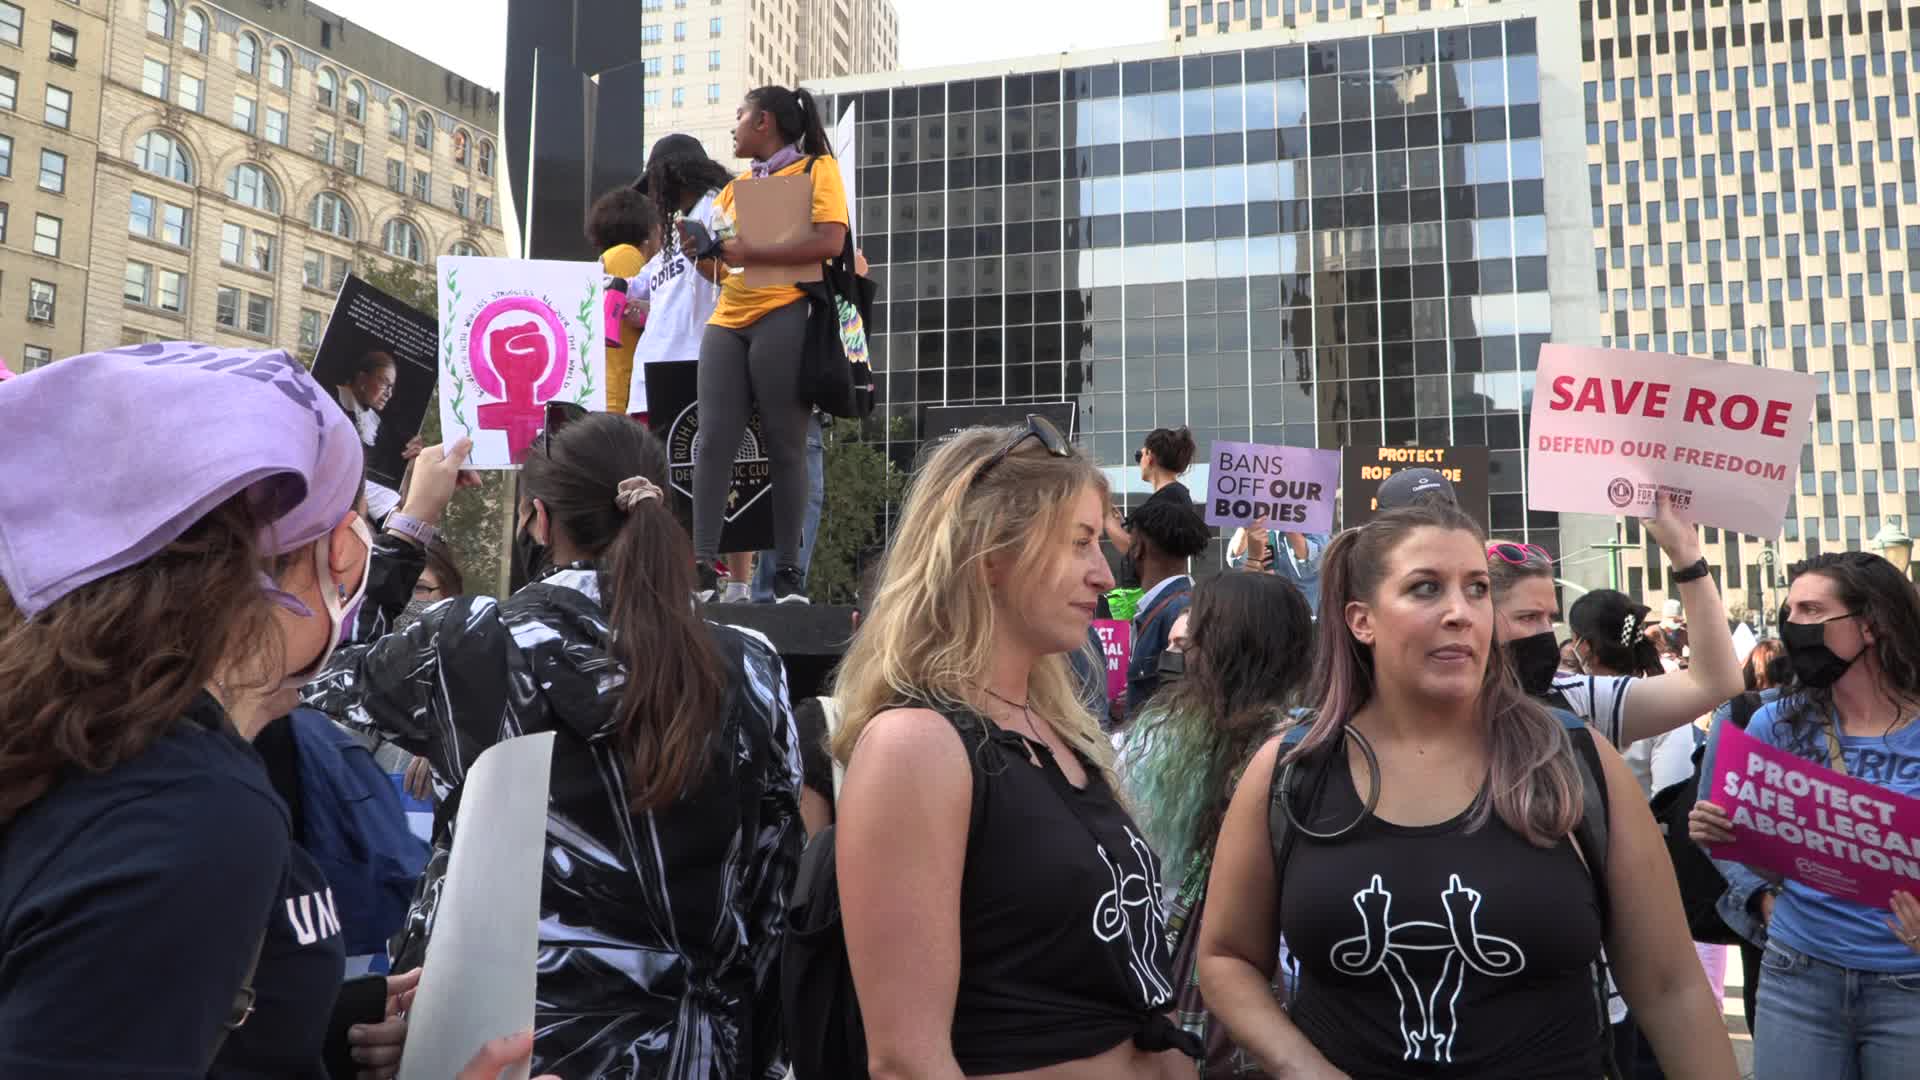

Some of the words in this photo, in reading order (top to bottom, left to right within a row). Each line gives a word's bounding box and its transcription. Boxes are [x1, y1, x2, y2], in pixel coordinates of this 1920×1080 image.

[651, 258, 685, 291] ODIES
[1550, 375, 1671, 419] SAVE
[1682, 388, 1793, 438] ROE
[673, 425, 693, 460] RUTH
[1378, 447, 1445, 462] PROTECT
[1538, 434, 1614, 456] DEFEND
[1620, 440, 1667, 460] OUR
[1672, 446, 1787, 481] FREEDOM
[748, 463, 769, 476] CLU
[1219, 452, 1283, 475] BANS
[1217, 475, 1265, 497] OFF
[1269, 479, 1322, 502] OUR
[1215, 498, 1307, 523] BODIES
[1723, 771, 1808, 827] SAFE,
[1747, 751, 1896, 826] PROTECT
[1731, 805, 1920, 881] ABORTION
